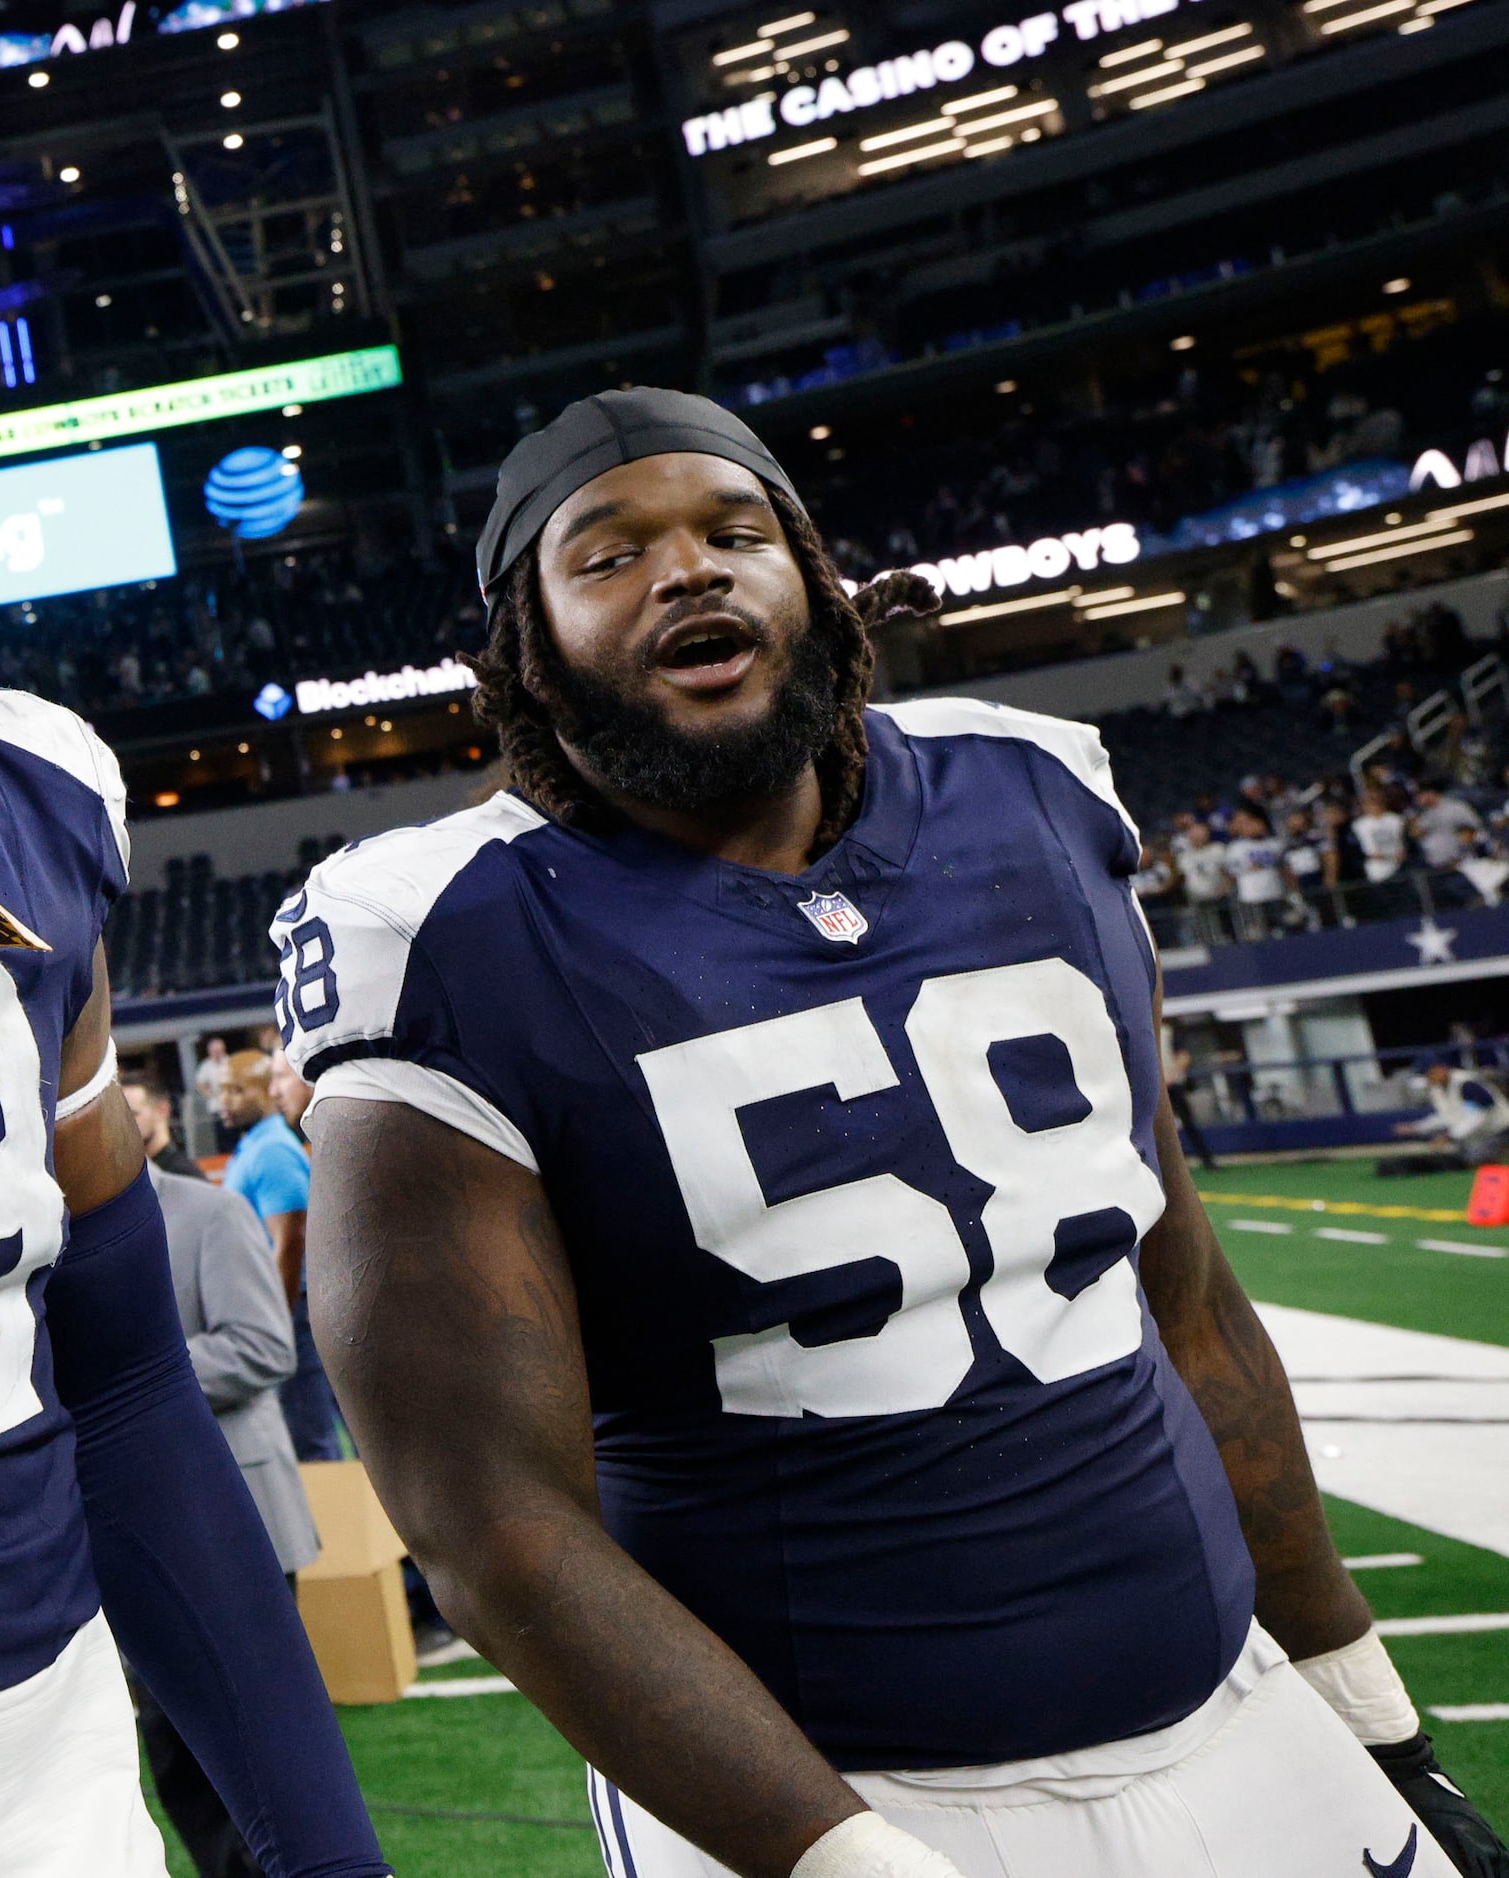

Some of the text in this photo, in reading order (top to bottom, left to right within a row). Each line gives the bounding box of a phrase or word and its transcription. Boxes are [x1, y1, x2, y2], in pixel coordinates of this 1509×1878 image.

[682, 95, 776, 156] THE
[780, 40, 975, 126] CASINO
[981, 12, 1059, 67] OF
[818, 909, 859, 933] NFL
[635, 957, 1167, 1418] 58
